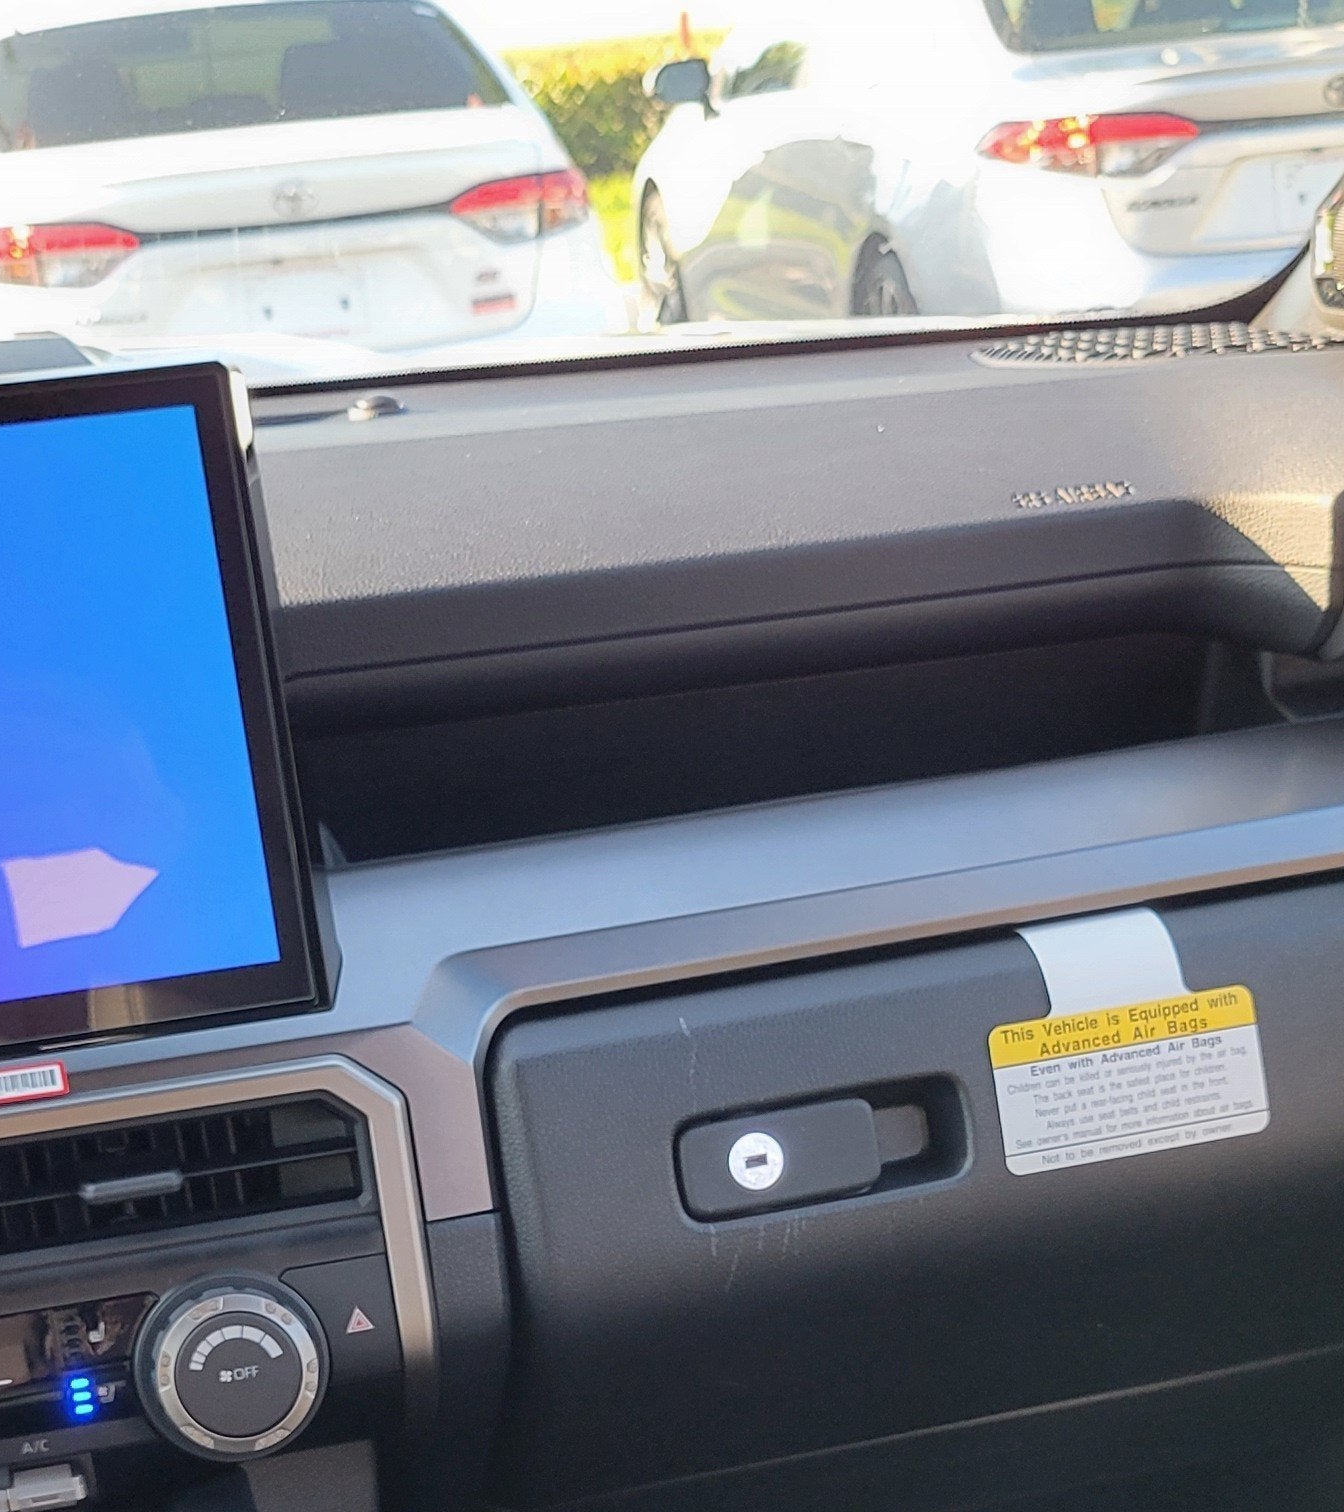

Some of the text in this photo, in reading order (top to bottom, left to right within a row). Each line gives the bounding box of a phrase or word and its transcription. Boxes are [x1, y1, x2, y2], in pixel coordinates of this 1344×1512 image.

[1000, 992, 1238, 1044] This Vehicle is Equipped with
[1040, 1018, 1208, 1057] Advanced Air Bags
[1030, 1035, 1222, 1077] Even with Advanced Air Bags
[1007, 1081, 1041, 1095] Children
[1041, 1153, 1060, 1165] Not
[1065, 1152, 1075, 1160] to
[1080, 1148, 1094, 1158] be
[1099, 1138, 1142, 1154] removed
[1147, 1132, 1180, 1146] except
[1184, 1129, 1196, 1140] by
[233, 1365, 259, 1381] OFF
[22, 1439, 50, 1455] A/C
